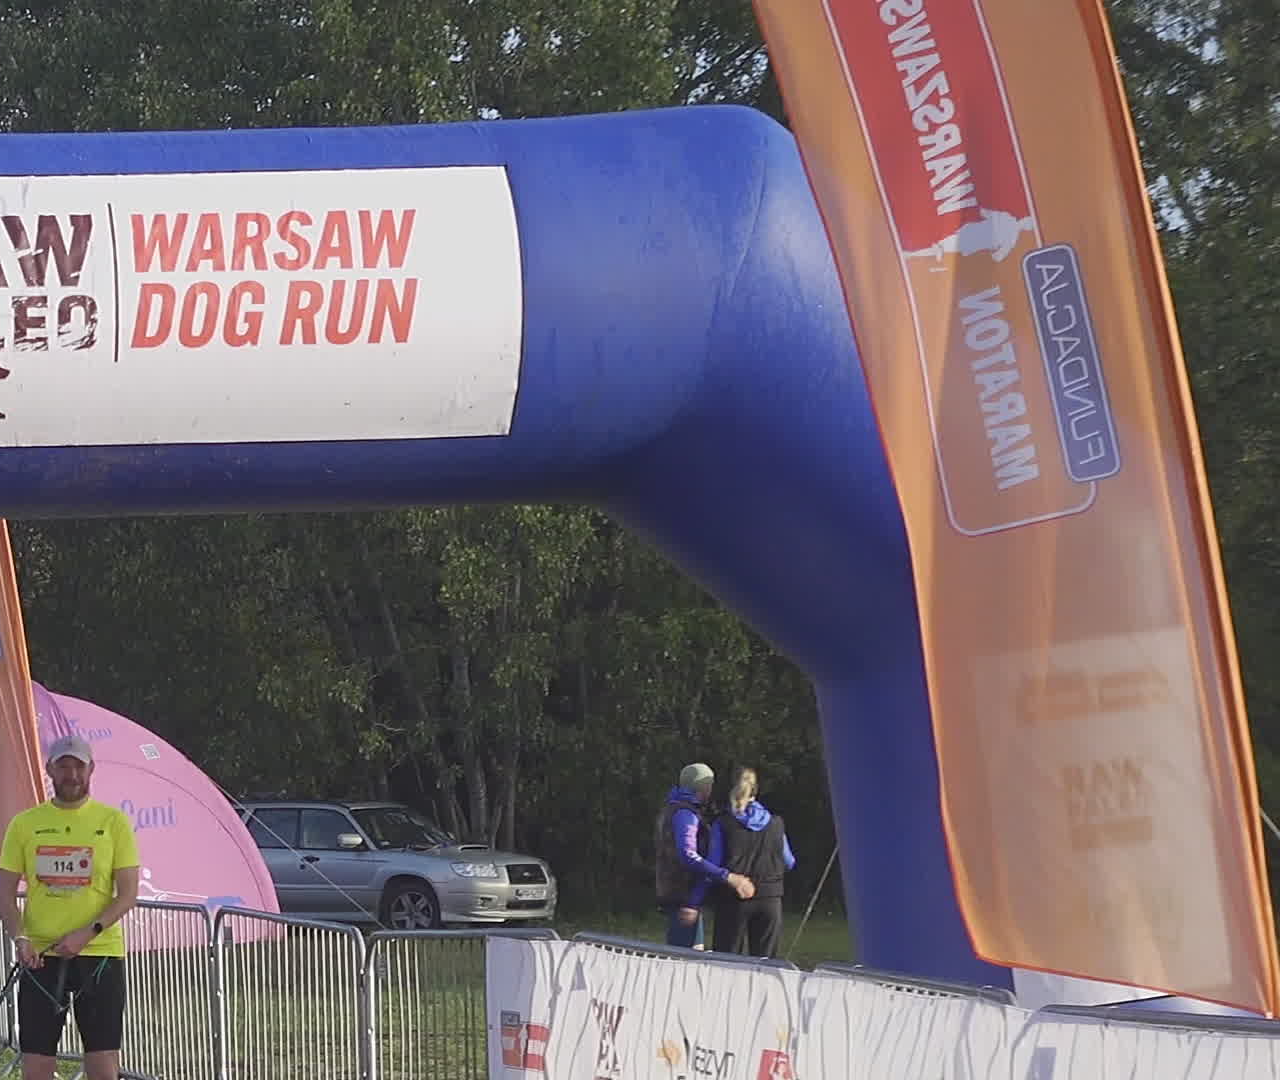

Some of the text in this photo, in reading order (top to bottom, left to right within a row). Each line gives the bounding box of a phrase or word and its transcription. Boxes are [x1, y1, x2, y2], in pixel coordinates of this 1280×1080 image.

[129, 207, 417, 273] WARSAW
[131, 277, 419, 349] DOG RUN
[54, 861, 74, 873] 114
